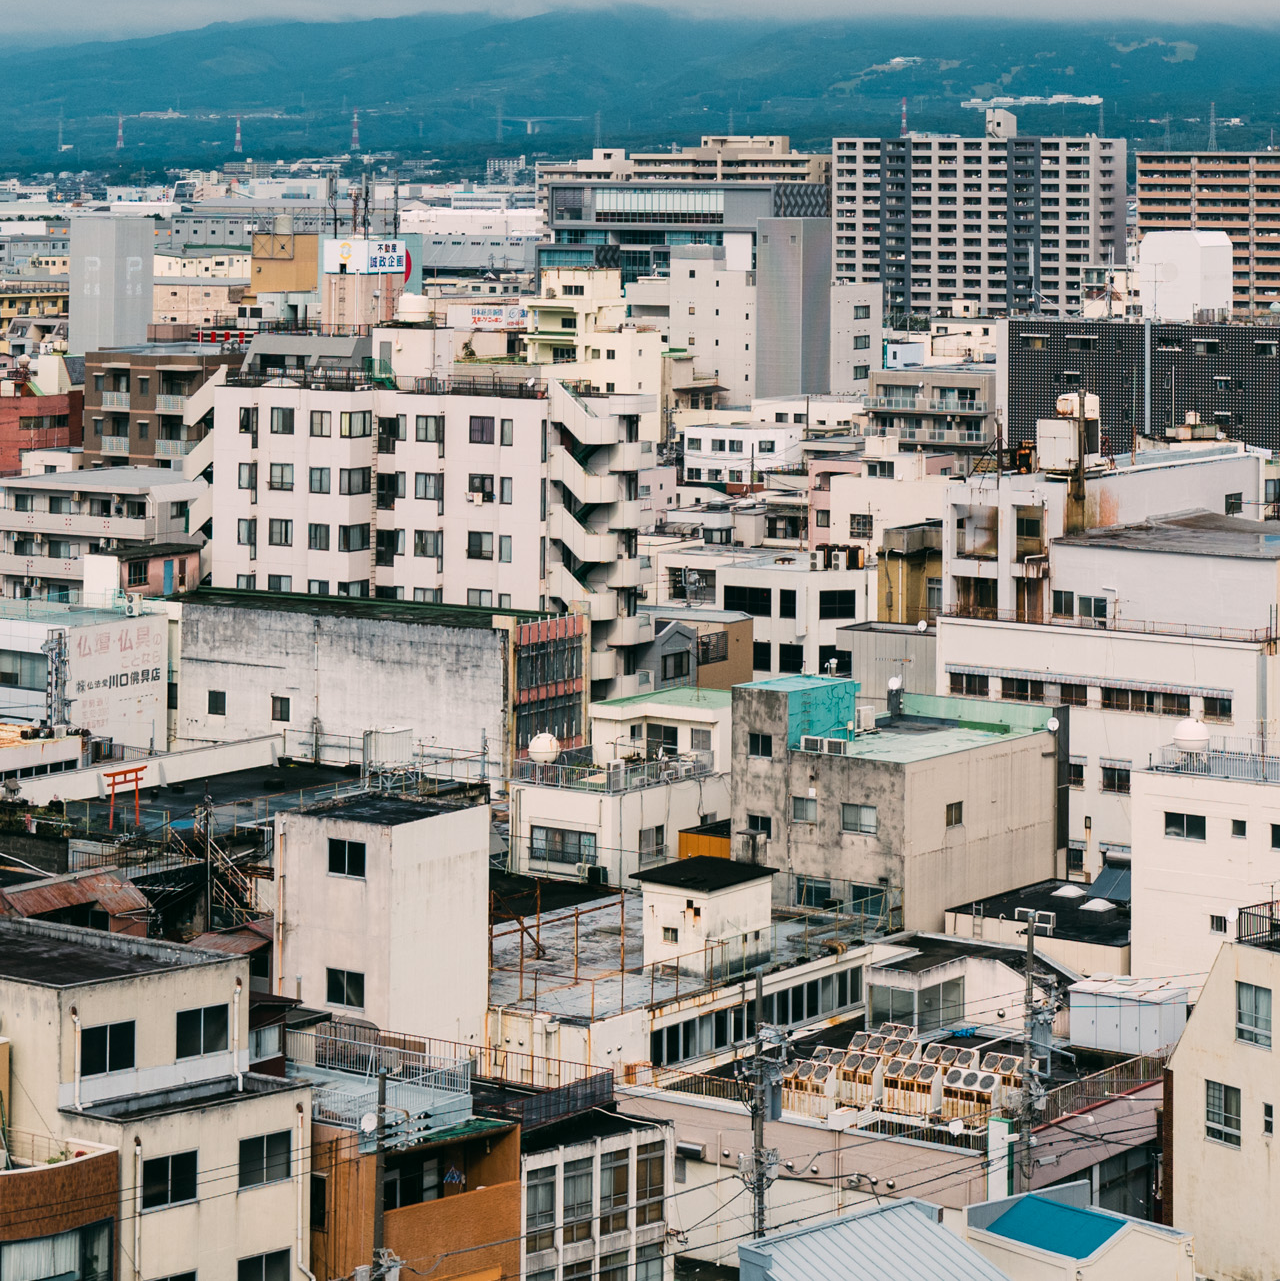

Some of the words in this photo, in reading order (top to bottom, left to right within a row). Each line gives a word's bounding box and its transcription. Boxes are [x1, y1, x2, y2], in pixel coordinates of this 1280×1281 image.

[377, 244, 397, 253] 不動産
[369, 255, 404, 268] 誠政企画
